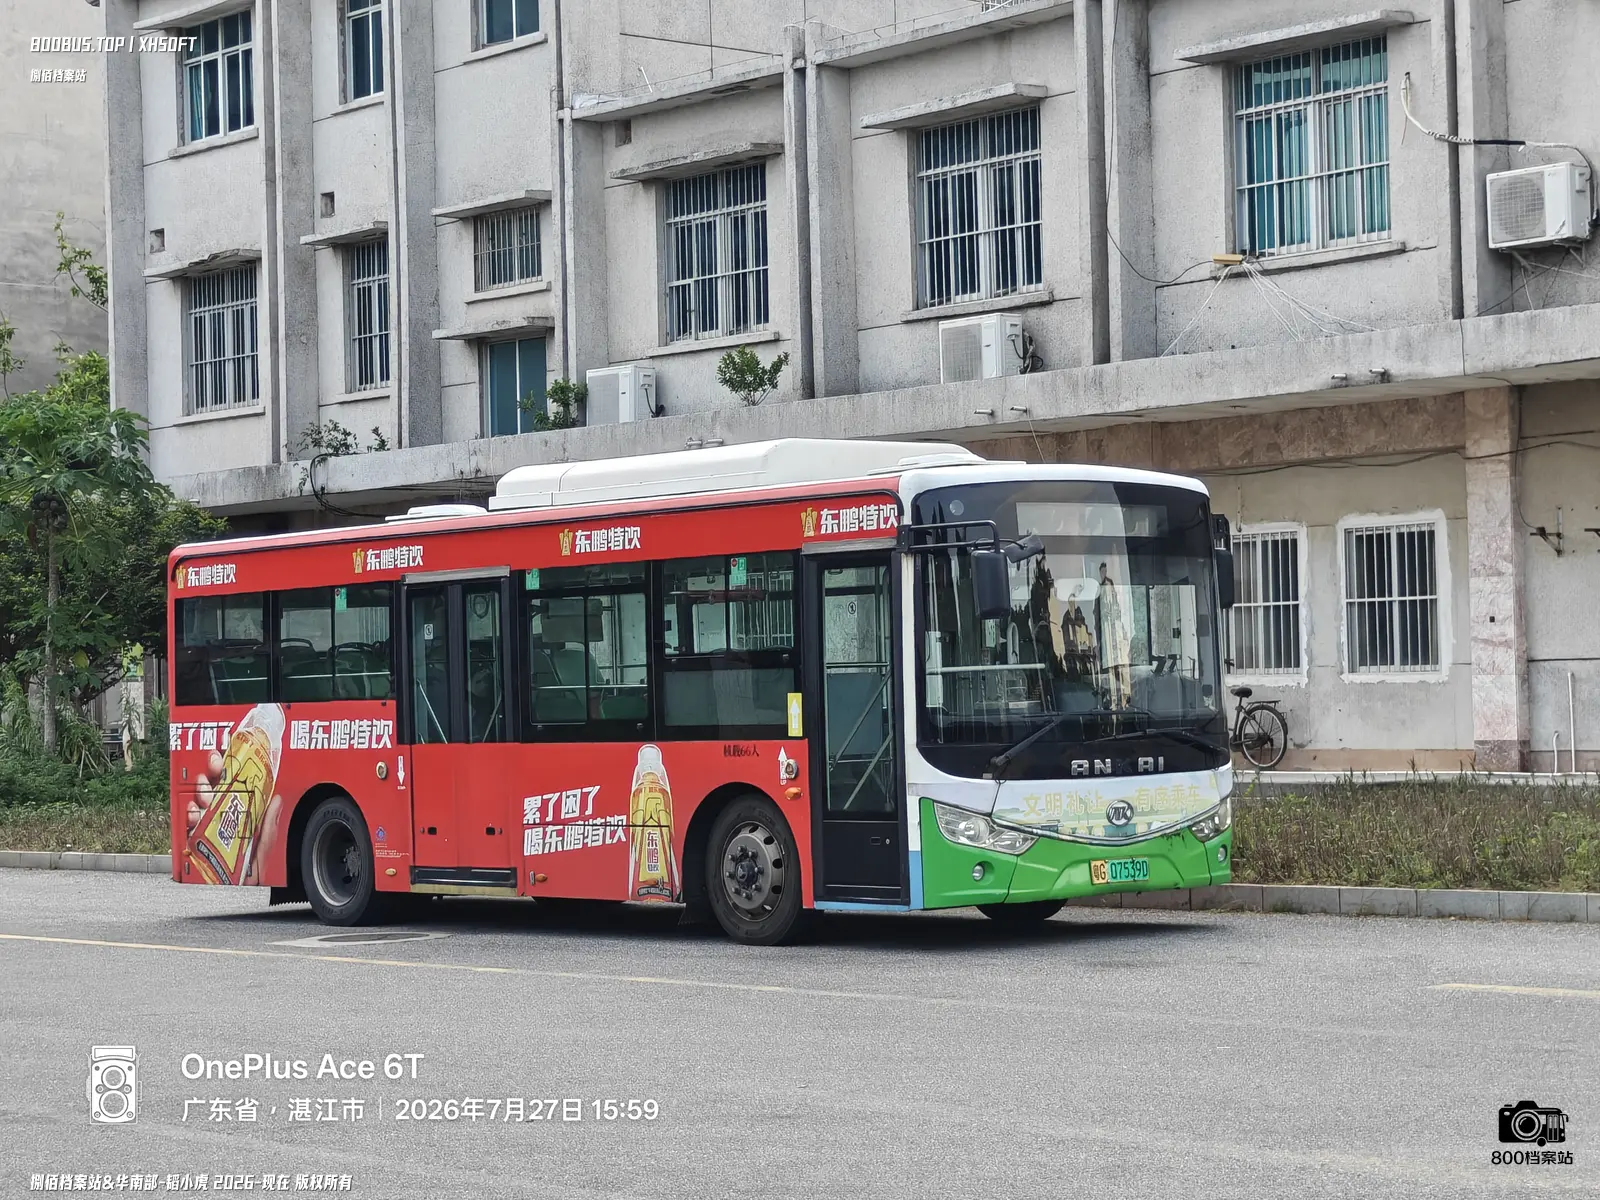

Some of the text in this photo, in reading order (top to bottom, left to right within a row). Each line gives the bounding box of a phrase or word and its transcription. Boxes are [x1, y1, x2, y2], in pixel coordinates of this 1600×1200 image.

[820, 503, 898, 534] 东鹏特饮
[575, 526, 641, 553] 东鹏特饮
[366, 545, 424, 571] 东鹏特饮
[187, 563, 236, 587] 东鹏特饮
[290, 719, 393, 750] 喝东鹏特饮
[523, 786, 600, 824] 累了困了
[1023, 784, 1201, 818] 文明礼让 有序乘车
[523, 815, 627, 856] 喝东鹏特饮
[1110, 859, 1149, 880] 07539D
